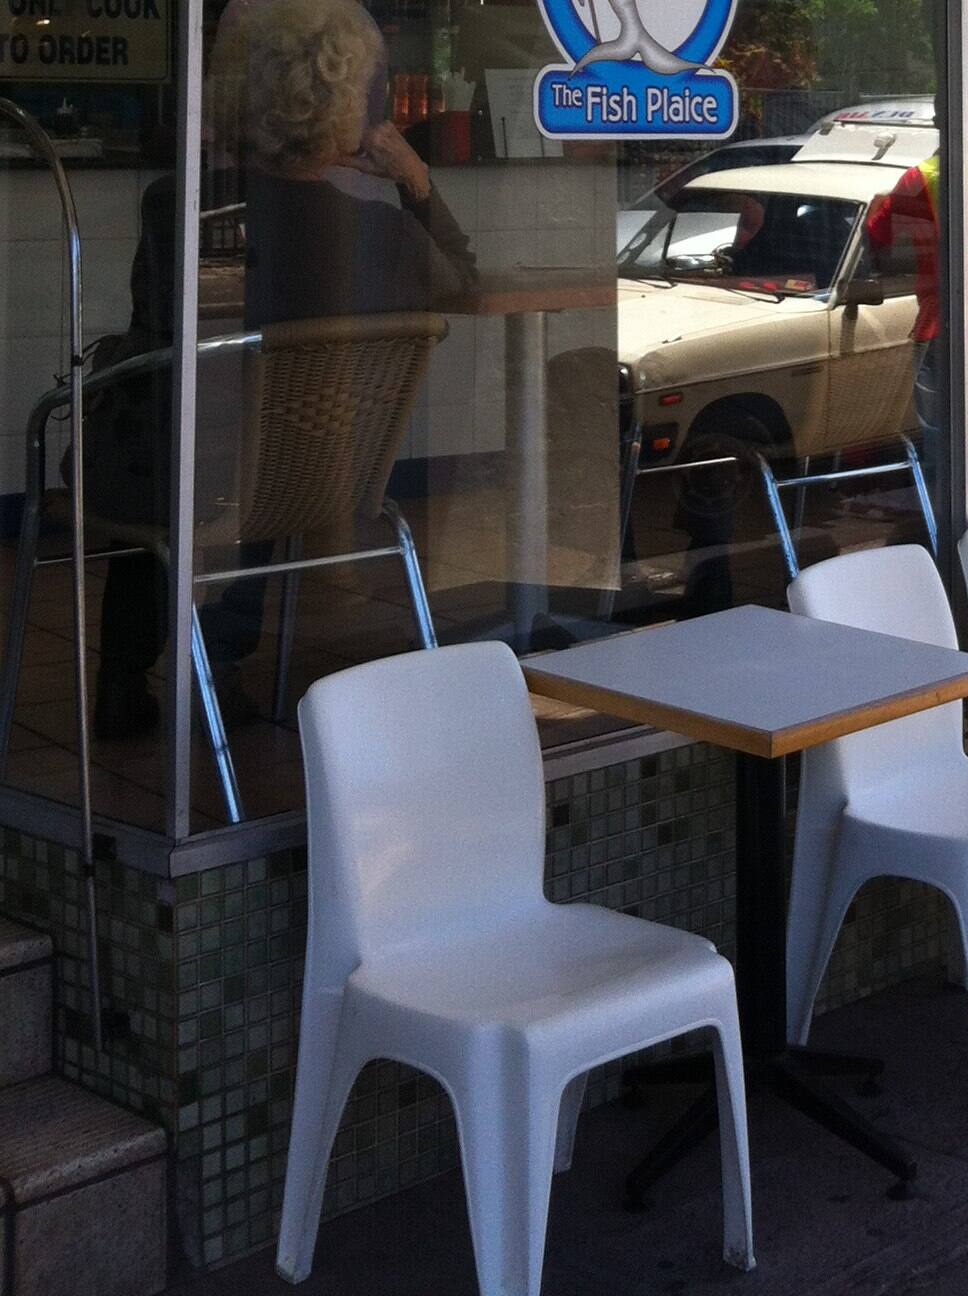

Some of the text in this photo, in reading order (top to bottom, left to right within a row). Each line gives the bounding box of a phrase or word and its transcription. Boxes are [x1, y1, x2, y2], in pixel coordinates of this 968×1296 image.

[39, 33, 130, 66] ORDER
[552, 83, 718, 123] The Fish Plaice
